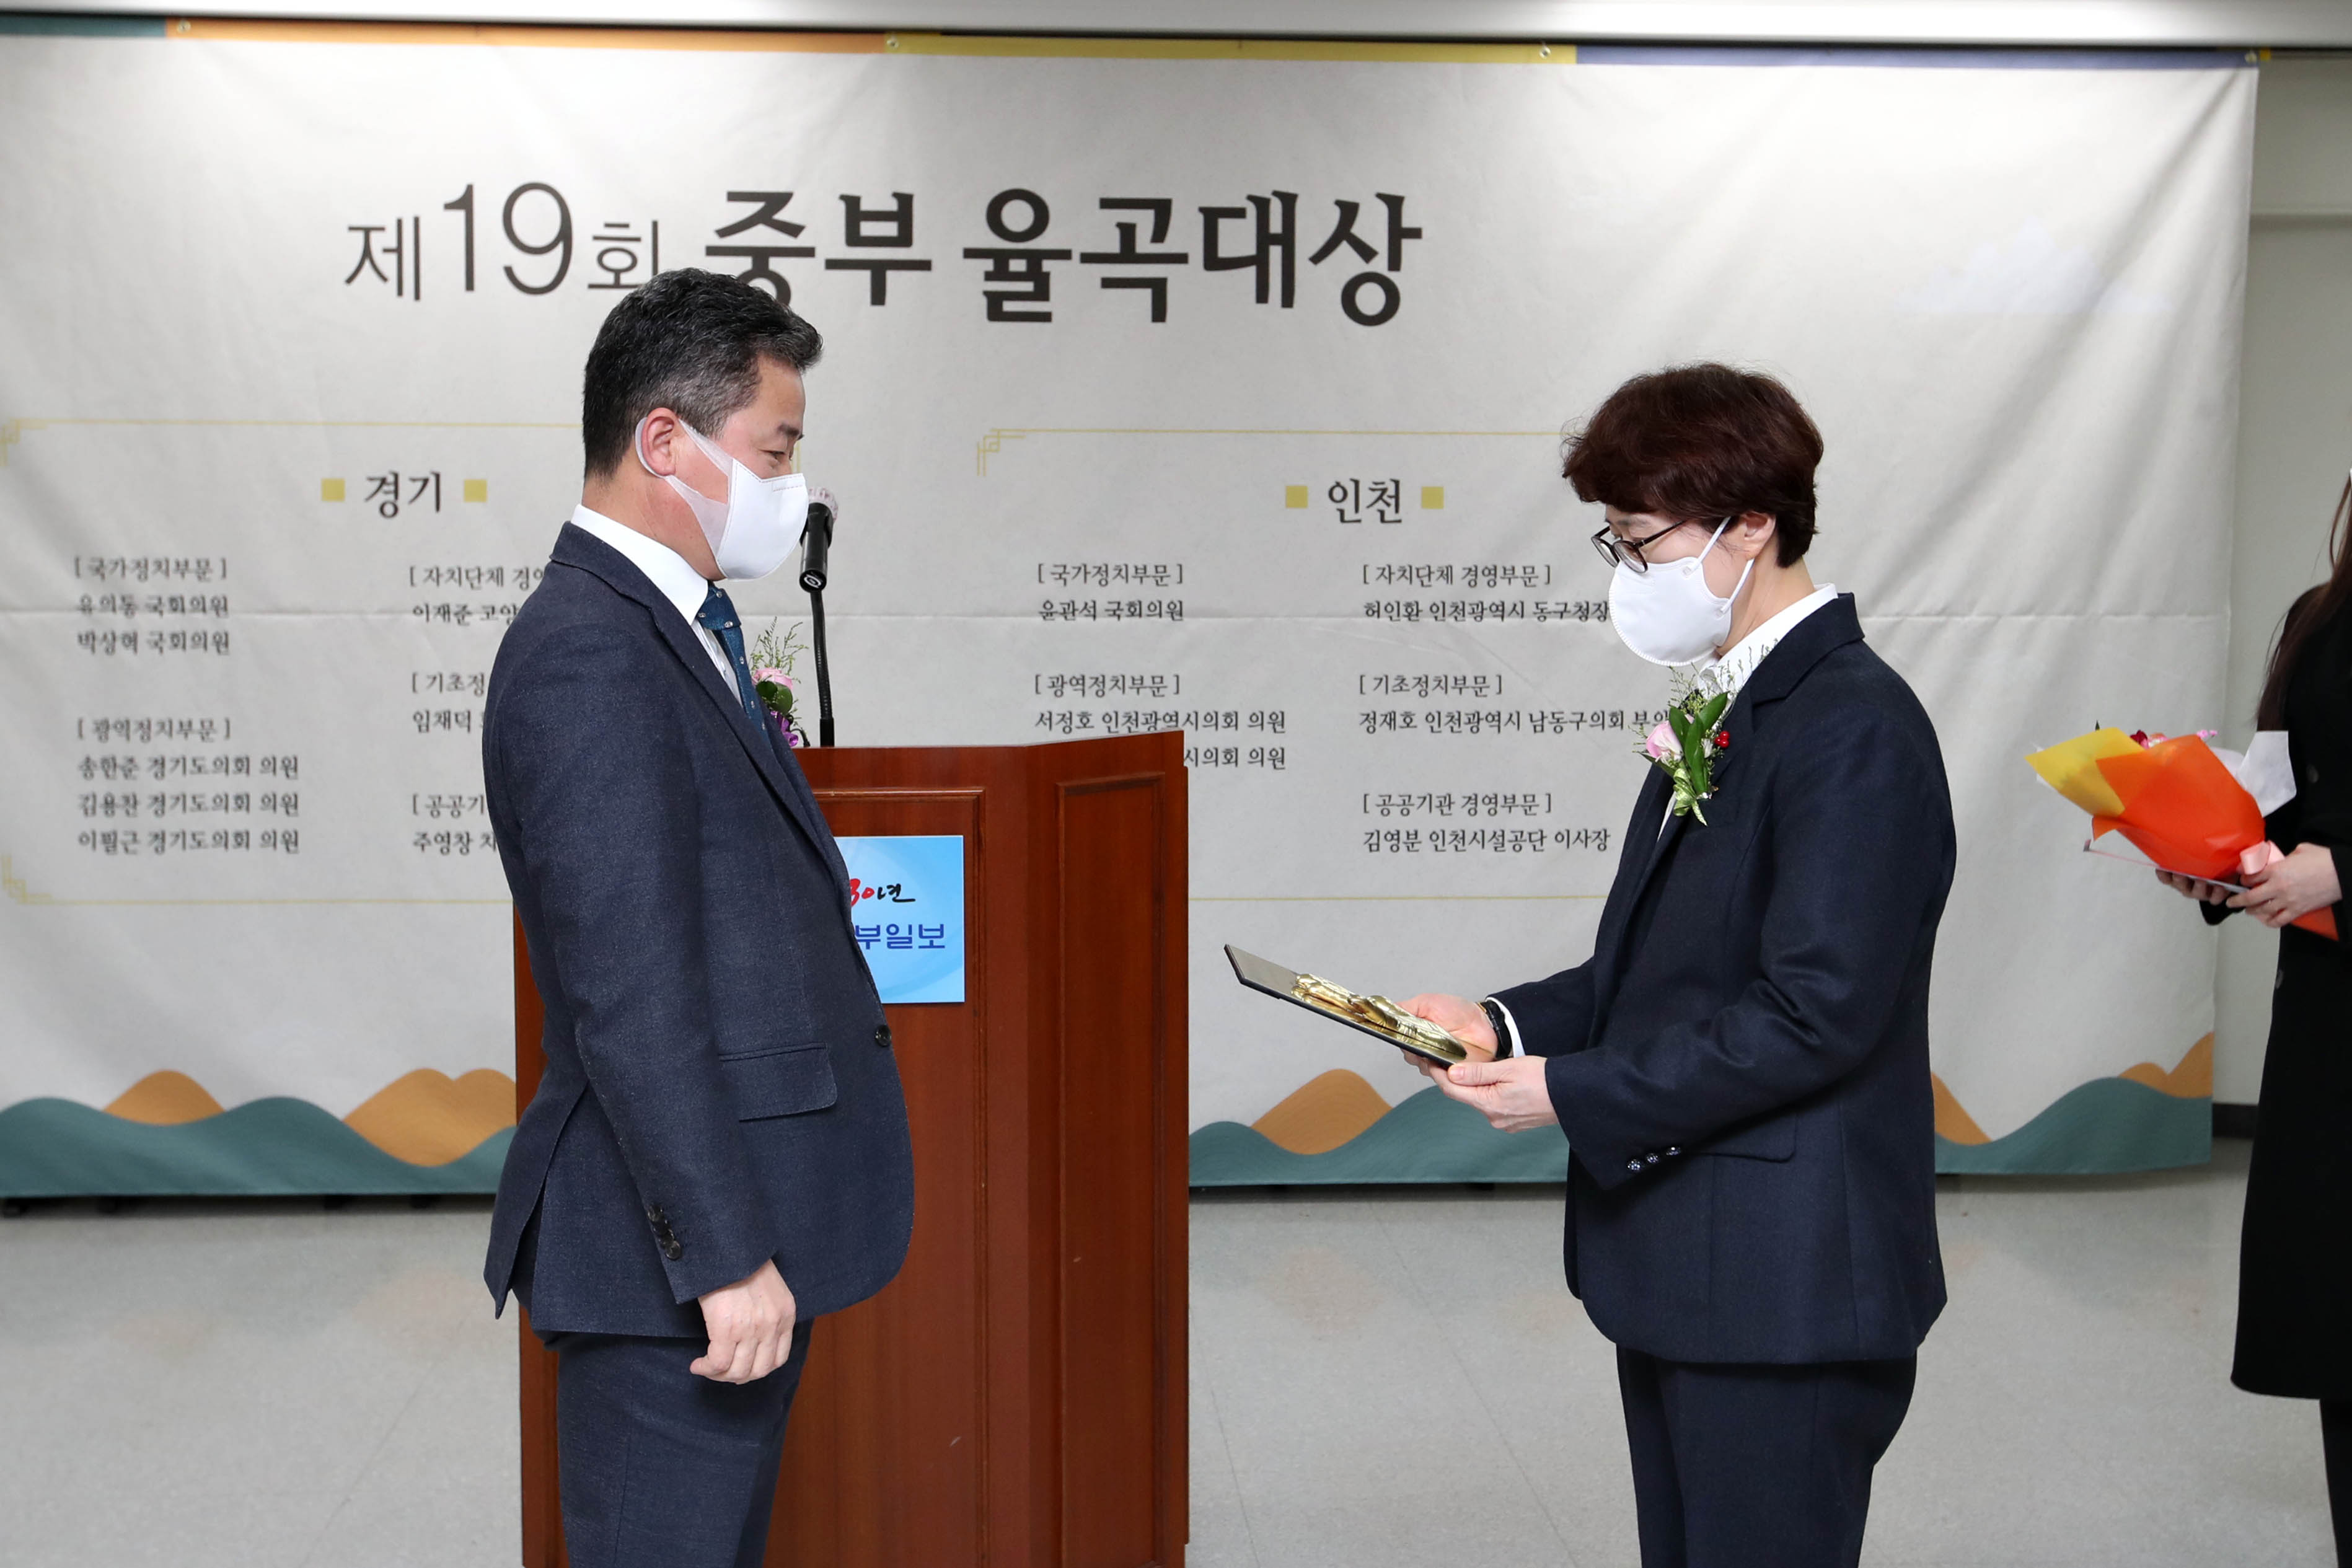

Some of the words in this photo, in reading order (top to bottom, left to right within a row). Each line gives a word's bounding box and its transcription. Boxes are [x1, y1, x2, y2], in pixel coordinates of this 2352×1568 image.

[343, 182, 659, 301] 제19회
[705, 190, 933, 309] 중부
[962, 188, 1423, 327] 율곡대상
[365, 471, 441, 519] 경기
[1328, 478, 1403, 524] 인천
[146, 594, 229, 619] 국회의원
[412, 603, 472, 627] 이재준
[1038, 599, 1097, 621] 윤관석
[1104, 600, 1184, 621] 국회의원
[1363, 600, 1422, 622] 허인환
[1429, 601, 1525, 622] 인천광역시
[1533, 601, 1610, 622] 동구청장
[77, 629, 139, 656] 박상혁
[146, 630, 230, 656] 국회의원
[1034, 710, 1095, 734] 서정호
[1101, 710, 1239, 733] 인천광역시의회
[1248, 710, 1286, 734] 의원
[1360, 710, 1417, 734] 정재호
[1425, 710, 1520, 734] 인천광역시
[1528, 710, 1624, 735] 남동구의회
[149, 754, 250, 780] 경기도의회
[260, 755, 299, 780] 의원
[1247, 746, 1285, 770] 의원
[148, 791, 251, 818] 경기도의회
[260, 791, 299, 817] 의원
[148, 829, 250, 855] 경기도의회
[260, 829, 299, 854] 의원
[1363, 829, 1422, 853] 김영분
[1429, 829, 1548, 853] 인천시설공단
[1554, 828, 1611, 852] 이사장
